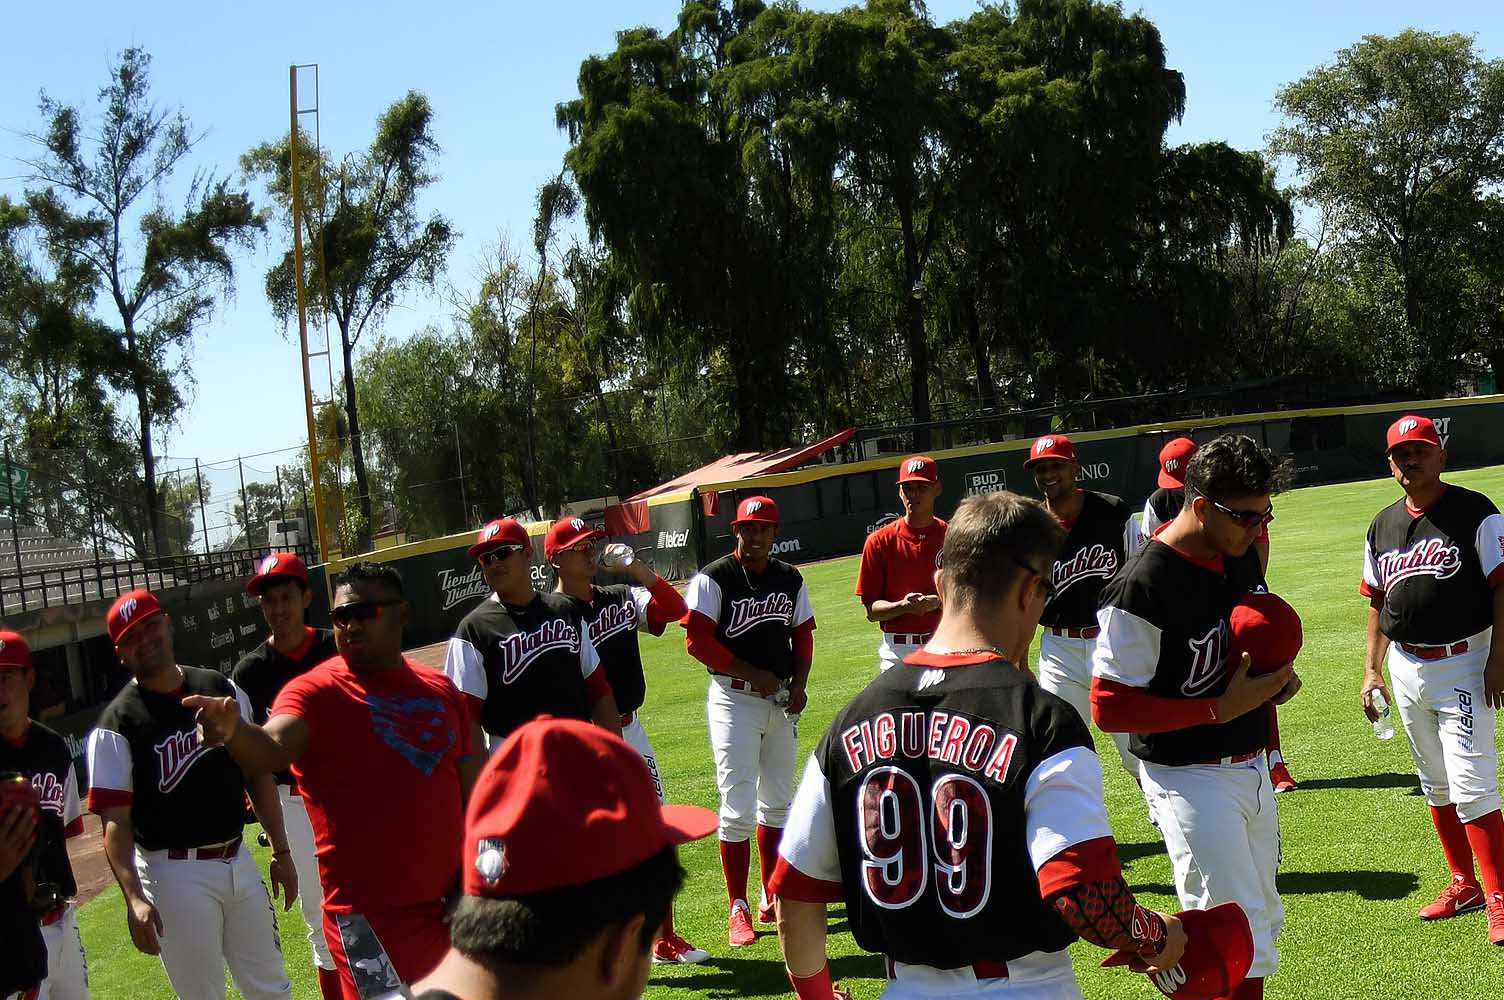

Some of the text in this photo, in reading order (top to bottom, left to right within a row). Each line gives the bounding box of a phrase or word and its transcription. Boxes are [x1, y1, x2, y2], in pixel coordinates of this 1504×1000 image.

[972, 472, 999, 487] BUD
[665, 528, 690, 549] telcel
[501, 618, 580, 685] Diablos
[842, 712, 1018, 783] FIGUEROA
[858, 765, 993, 919] 99
